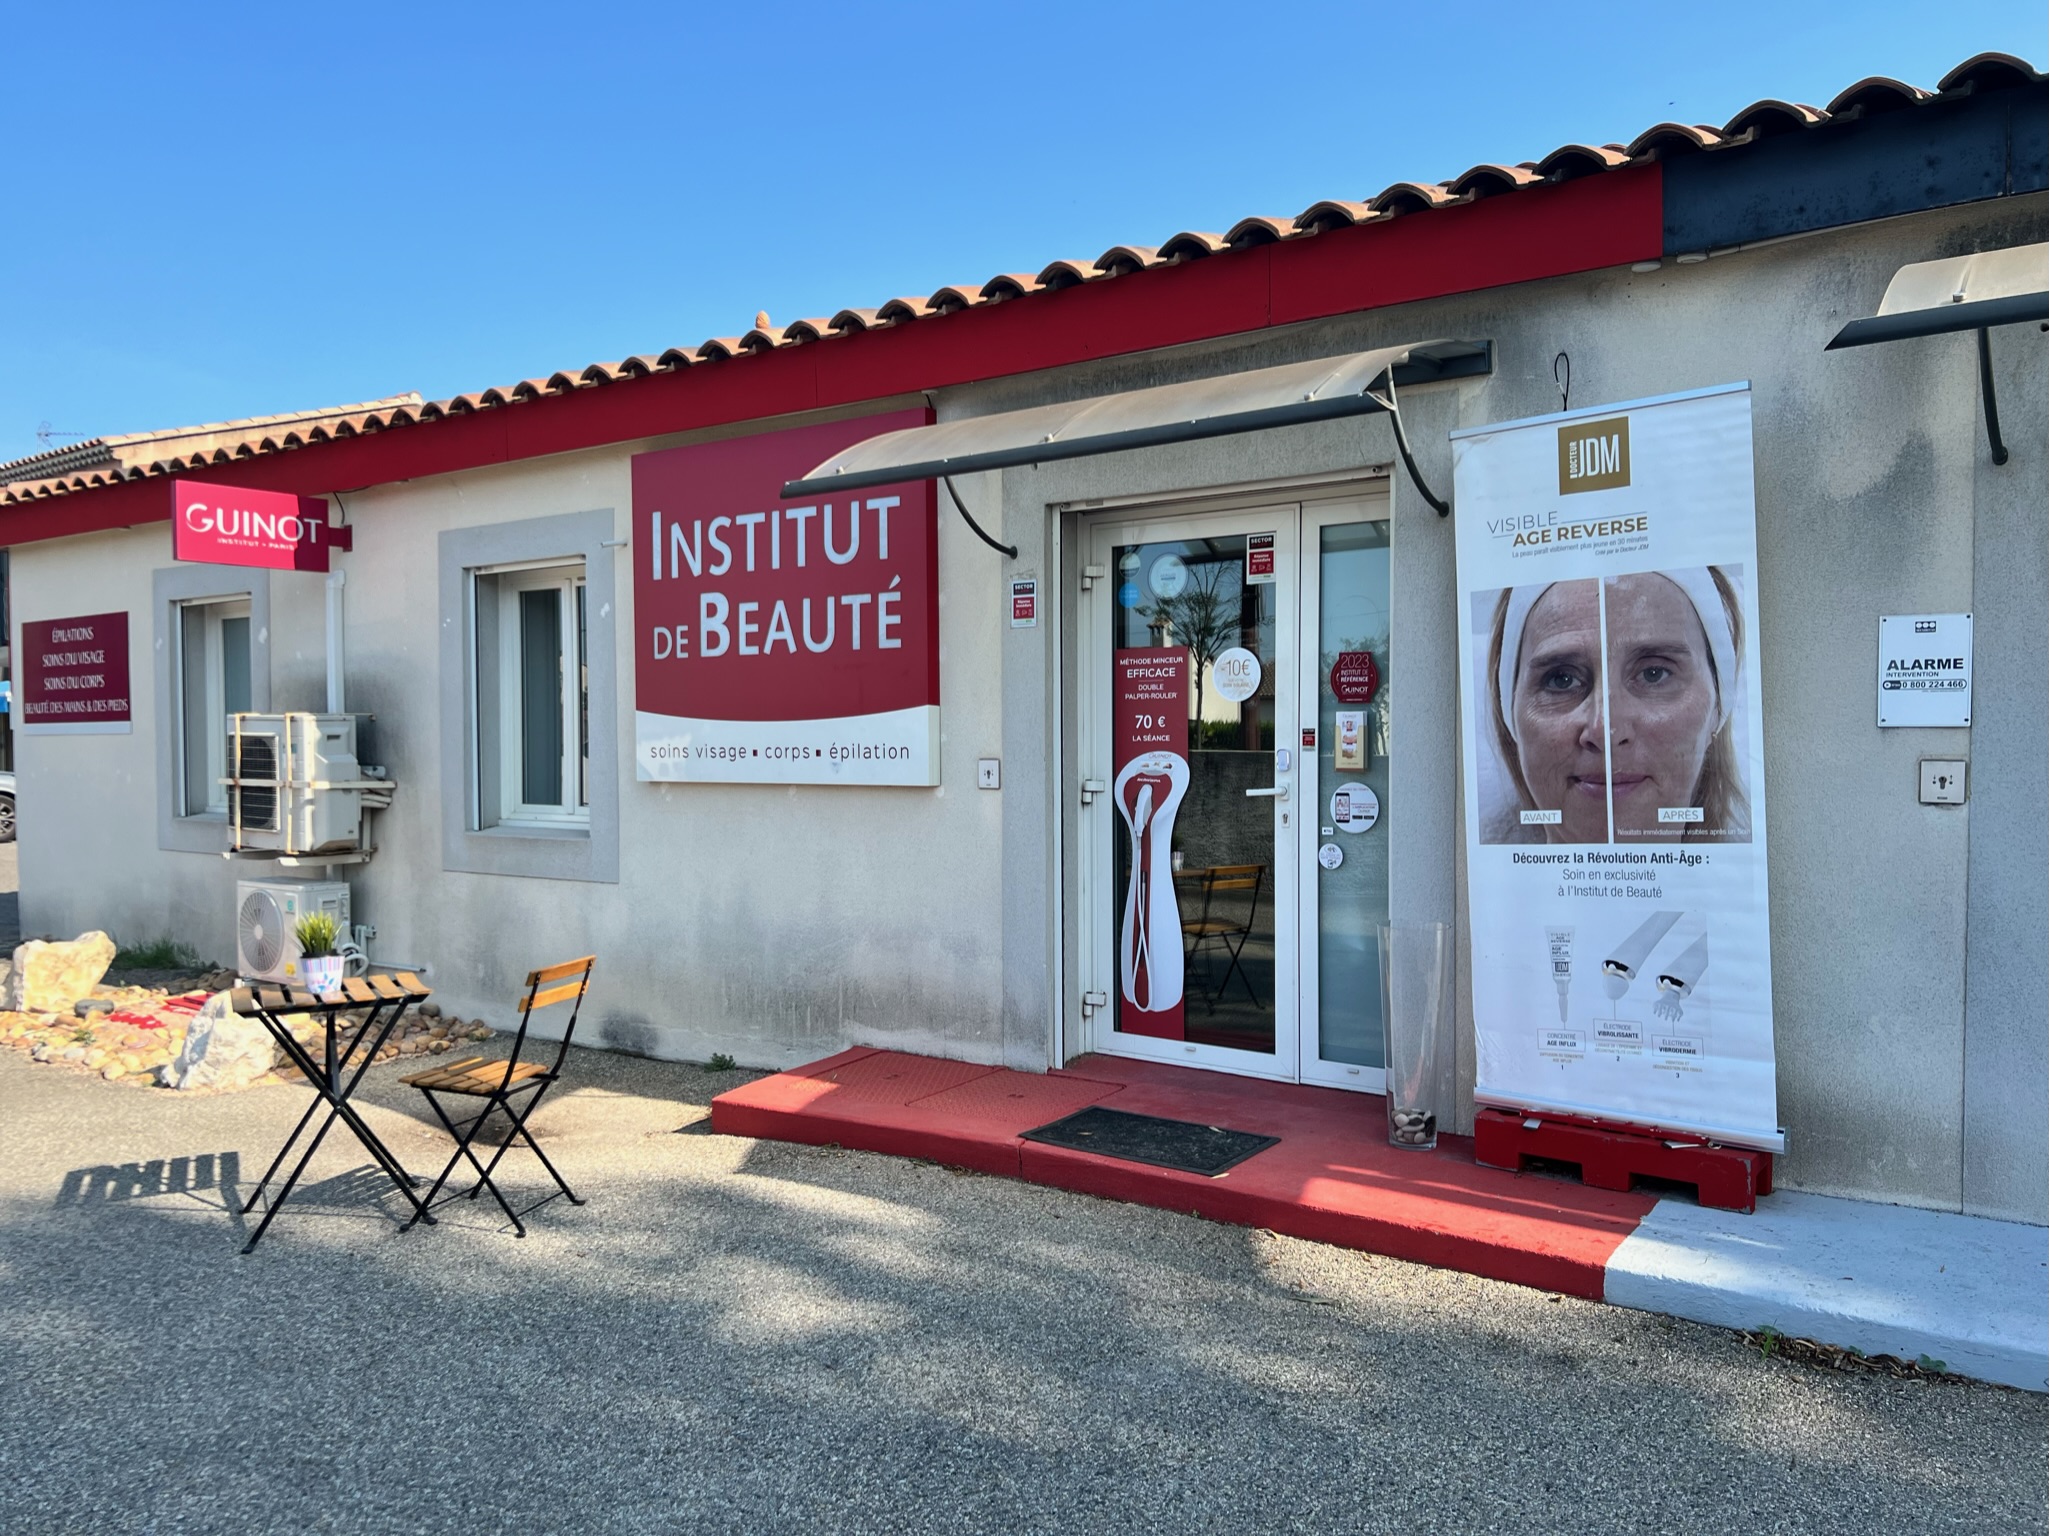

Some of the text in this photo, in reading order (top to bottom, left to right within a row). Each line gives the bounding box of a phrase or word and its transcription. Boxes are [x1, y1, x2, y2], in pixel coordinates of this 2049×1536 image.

[1569, 441, 1577, 474] DOCTEUR
[1578, 434, 1620, 478] JDM
[186, 503, 323, 543] GUINOT
[1486, 511, 1558, 534] VISIBLE
[652, 495, 901, 580] INSTITUT
[1512, 516, 1648, 547] AGE REVERSE
[217, 537, 295, 551] INSTITUT PARIS
[1251, 536, 1273, 544] SECTOR
[1580, 542, 1592, 551] plus
[653, 574, 902, 660] DE BEAUTÉ
[52, 627, 94, 643] ÉPILATIONS
[42, 653, 64, 667] SOINS
[1120, 656, 1183, 665] MÉTHODE MINCEUR
[1341, 654, 1369, 668] 2023
[1887, 658, 1964, 671] ALARME
[1127, 667, 1175, 678] EFFICACE
[44, 677, 66, 690] SOINS
[80, 674, 105, 688] CORPS
[1341, 684, 1368, 693] GUINOT
[1928, 680, 1944, 688] 224
[1947, 680, 1964, 688] 466
[1135, 715, 1166, 729] 70 €
[1143, 733, 1170, 742] SÉANCE
[650, 742, 910, 763] soins visage corps épilation
[1523, 812, 1557, 822] AVANT
[1662, 809, 1699, 820] APRÈS
[1513, 852, 1570, 864] Découvrez
[1573, 852, 1584, 863] la
[1587, 851, 1647, 863] Révolution
[1650, 850, 1702, 867] Anti-Âge
[1562, 869, 1656, 881] Soin en exclusivité
[1558, 885, 1662, 898] à l'Institut de Beauté
